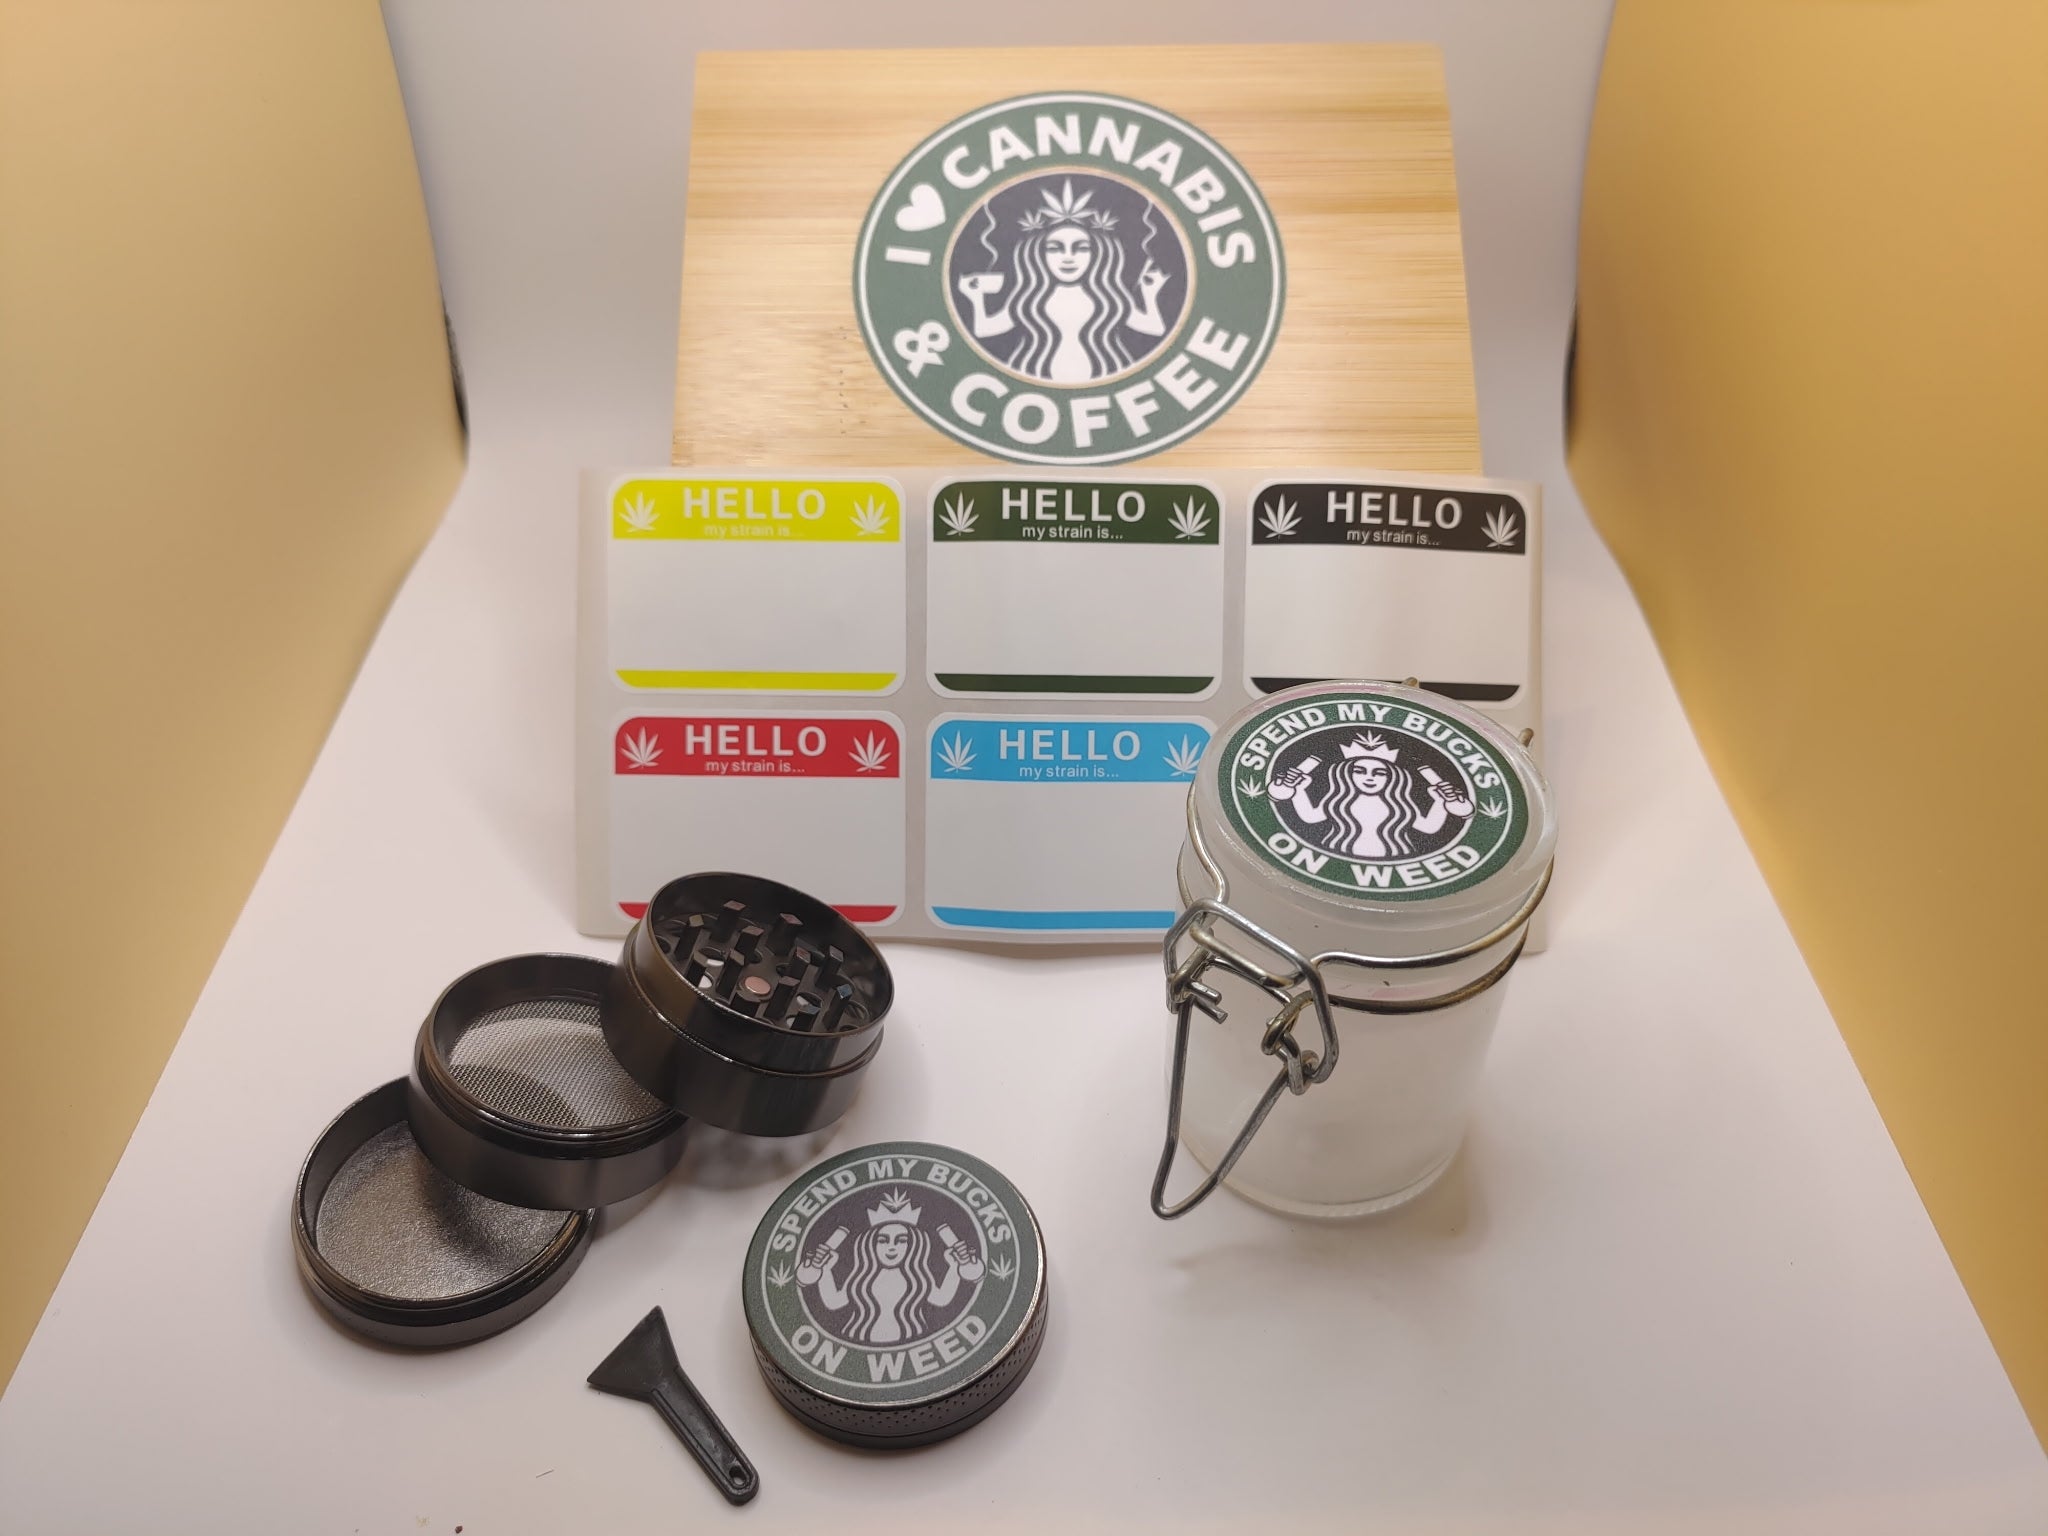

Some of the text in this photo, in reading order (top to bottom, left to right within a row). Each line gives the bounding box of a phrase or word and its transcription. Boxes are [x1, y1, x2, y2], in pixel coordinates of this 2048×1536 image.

[885, 114, 1256, 268] I CANNABIS
[893, 317, 1250, 448] & COFFEE
[684, 487, 826, 520] HELLO
[1002, 488, 1146, 523] HELLO
[1327, 490, 1463, 529] HELLO
[1022, 526, 1045, 540] my
[1049, 525, 1093, 539] strain
[1346, 530, 1370, 544] my
[1373, 530, 1413, 544] strain
[685, 724, 826, 757] HELLO
[1000, 729, 1141, 761] HELLO
[1240, 703, 1501, 789] SPEND MY BUCKS
[706, 760, 728, 774] my
[732, 759, 774, 772] strain
[1019, 766, 1042, 780] my
[1046, 765, 1089, 777] strain
[1267, 832, 1481, 887] ON WEED
[772, 1158, 1011, 1252] SPEND MY BUCKS
[791, 1315, 987, 1383] ON WEED
